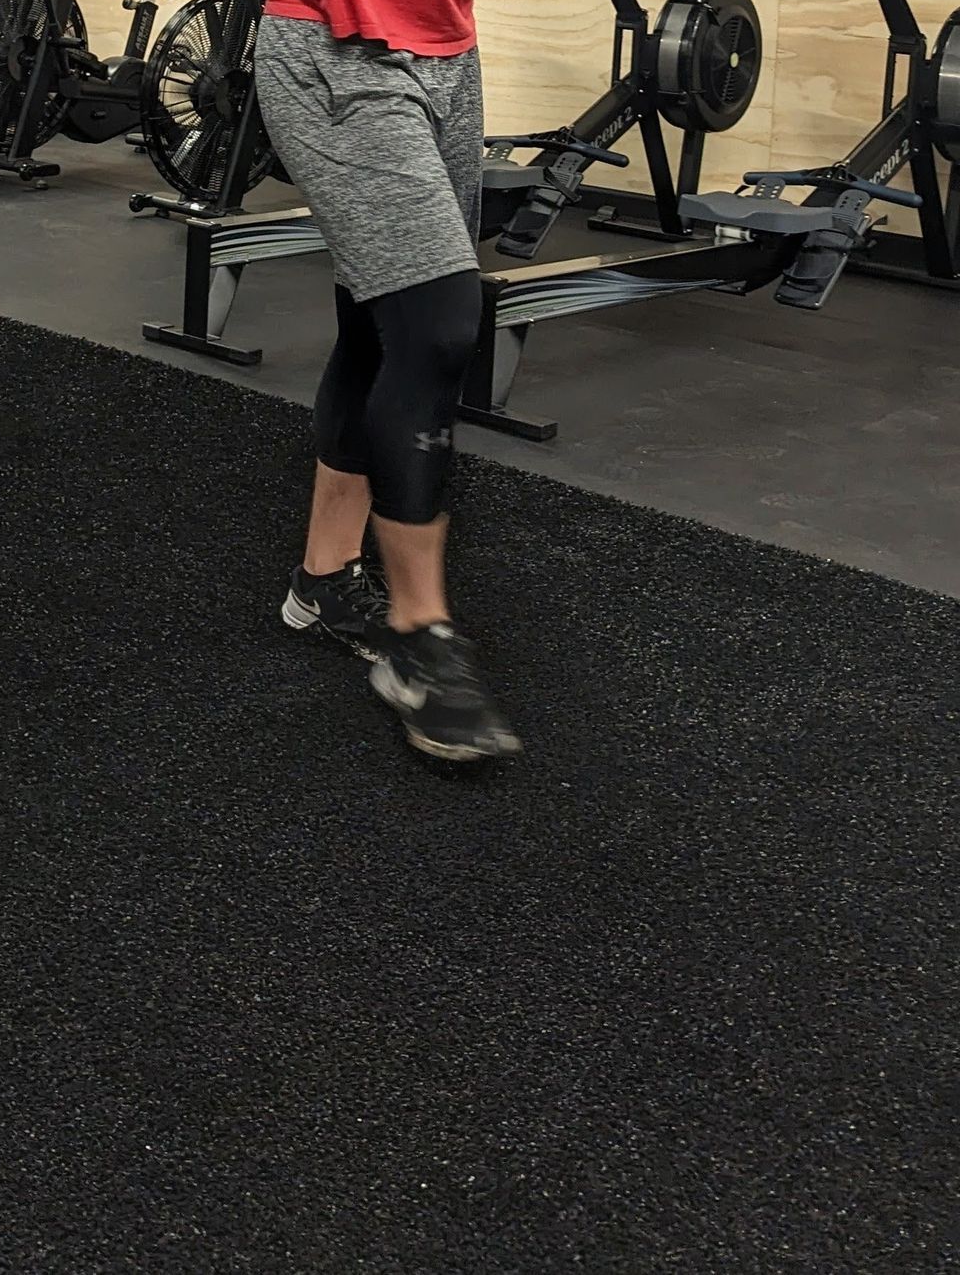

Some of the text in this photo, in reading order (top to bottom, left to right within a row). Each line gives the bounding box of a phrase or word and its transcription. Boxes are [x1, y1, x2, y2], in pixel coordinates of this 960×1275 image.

[591, 106, 632, 149] cept 2
[869, 138, 910, 184] cept 2
